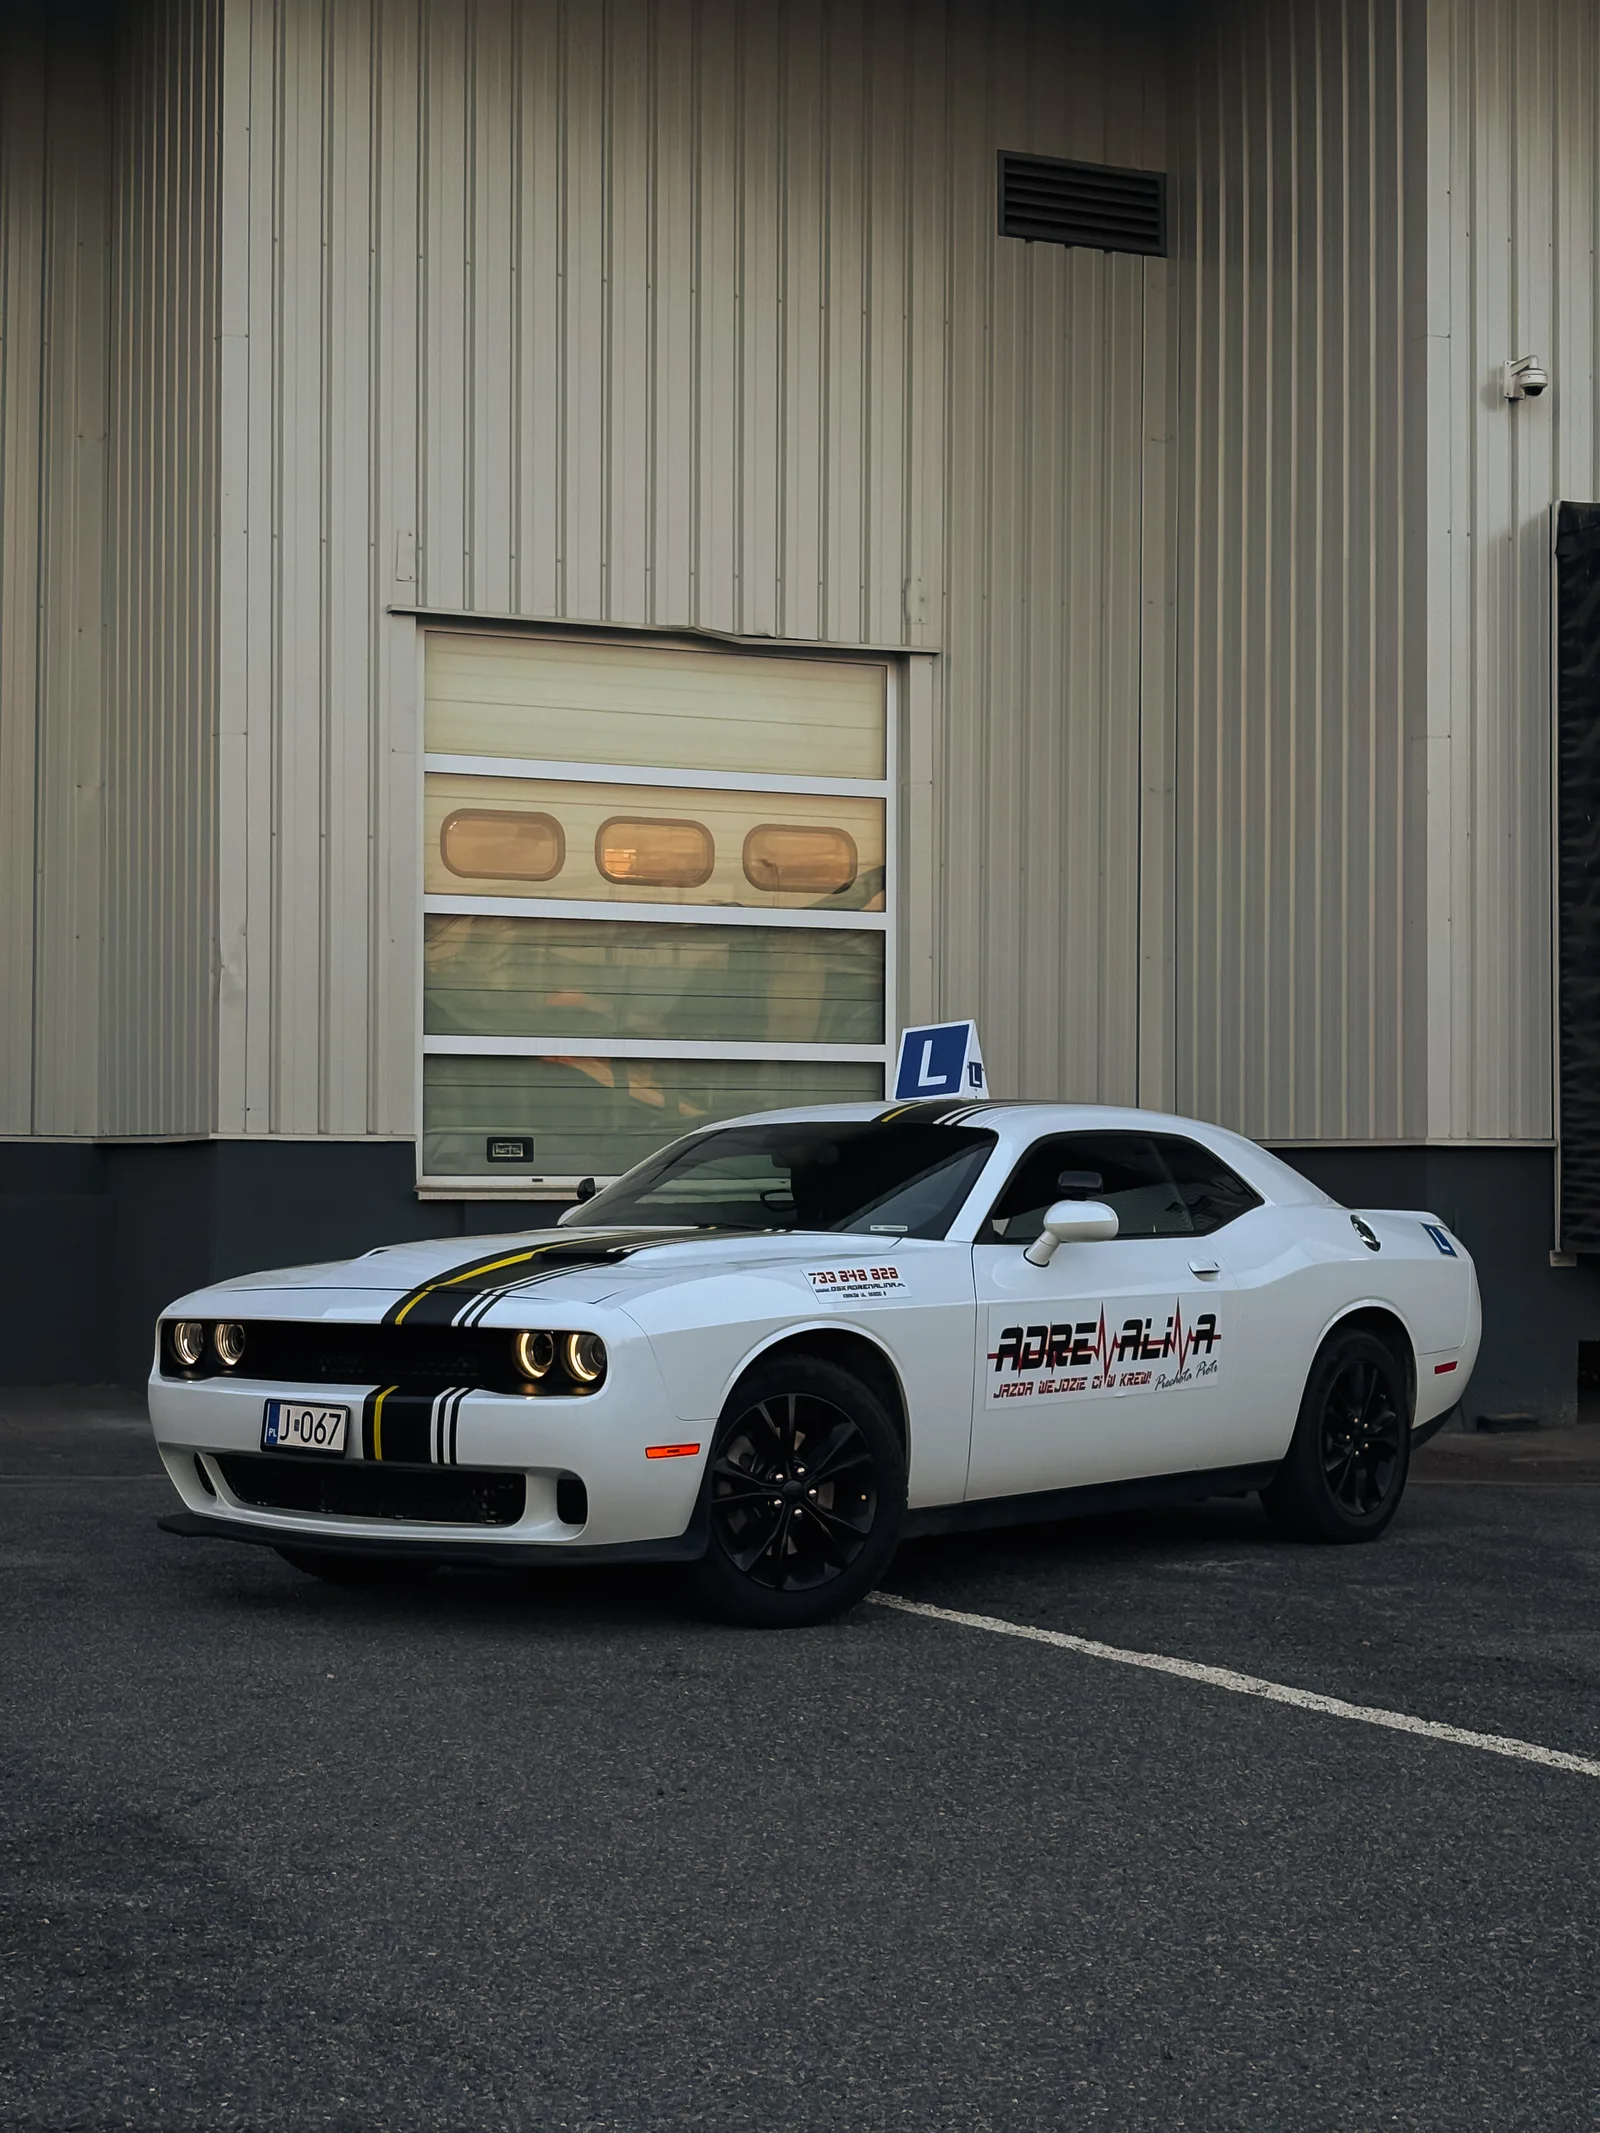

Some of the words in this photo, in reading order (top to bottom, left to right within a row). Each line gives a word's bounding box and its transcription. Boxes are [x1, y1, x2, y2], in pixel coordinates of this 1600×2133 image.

[918, 1040, 947, 1087] L
[972, 1064, 981, 1085] L
[1429, 1228, 1451, 1251] L
[808, 1271, 837, 1285] 733
[838, 1269, 868, 1283] 848
[870, 1267, 899, 1280] 828
[1196, 1359, 1218, 1378] Piotr
[993, 1382, 1034, 1398] JAZDA
[1038, 1376, 1088, 1395] WEJDZIE
[1106, 1374, 1116, 1388] W
[268, 1428, 277, 1437] PL
